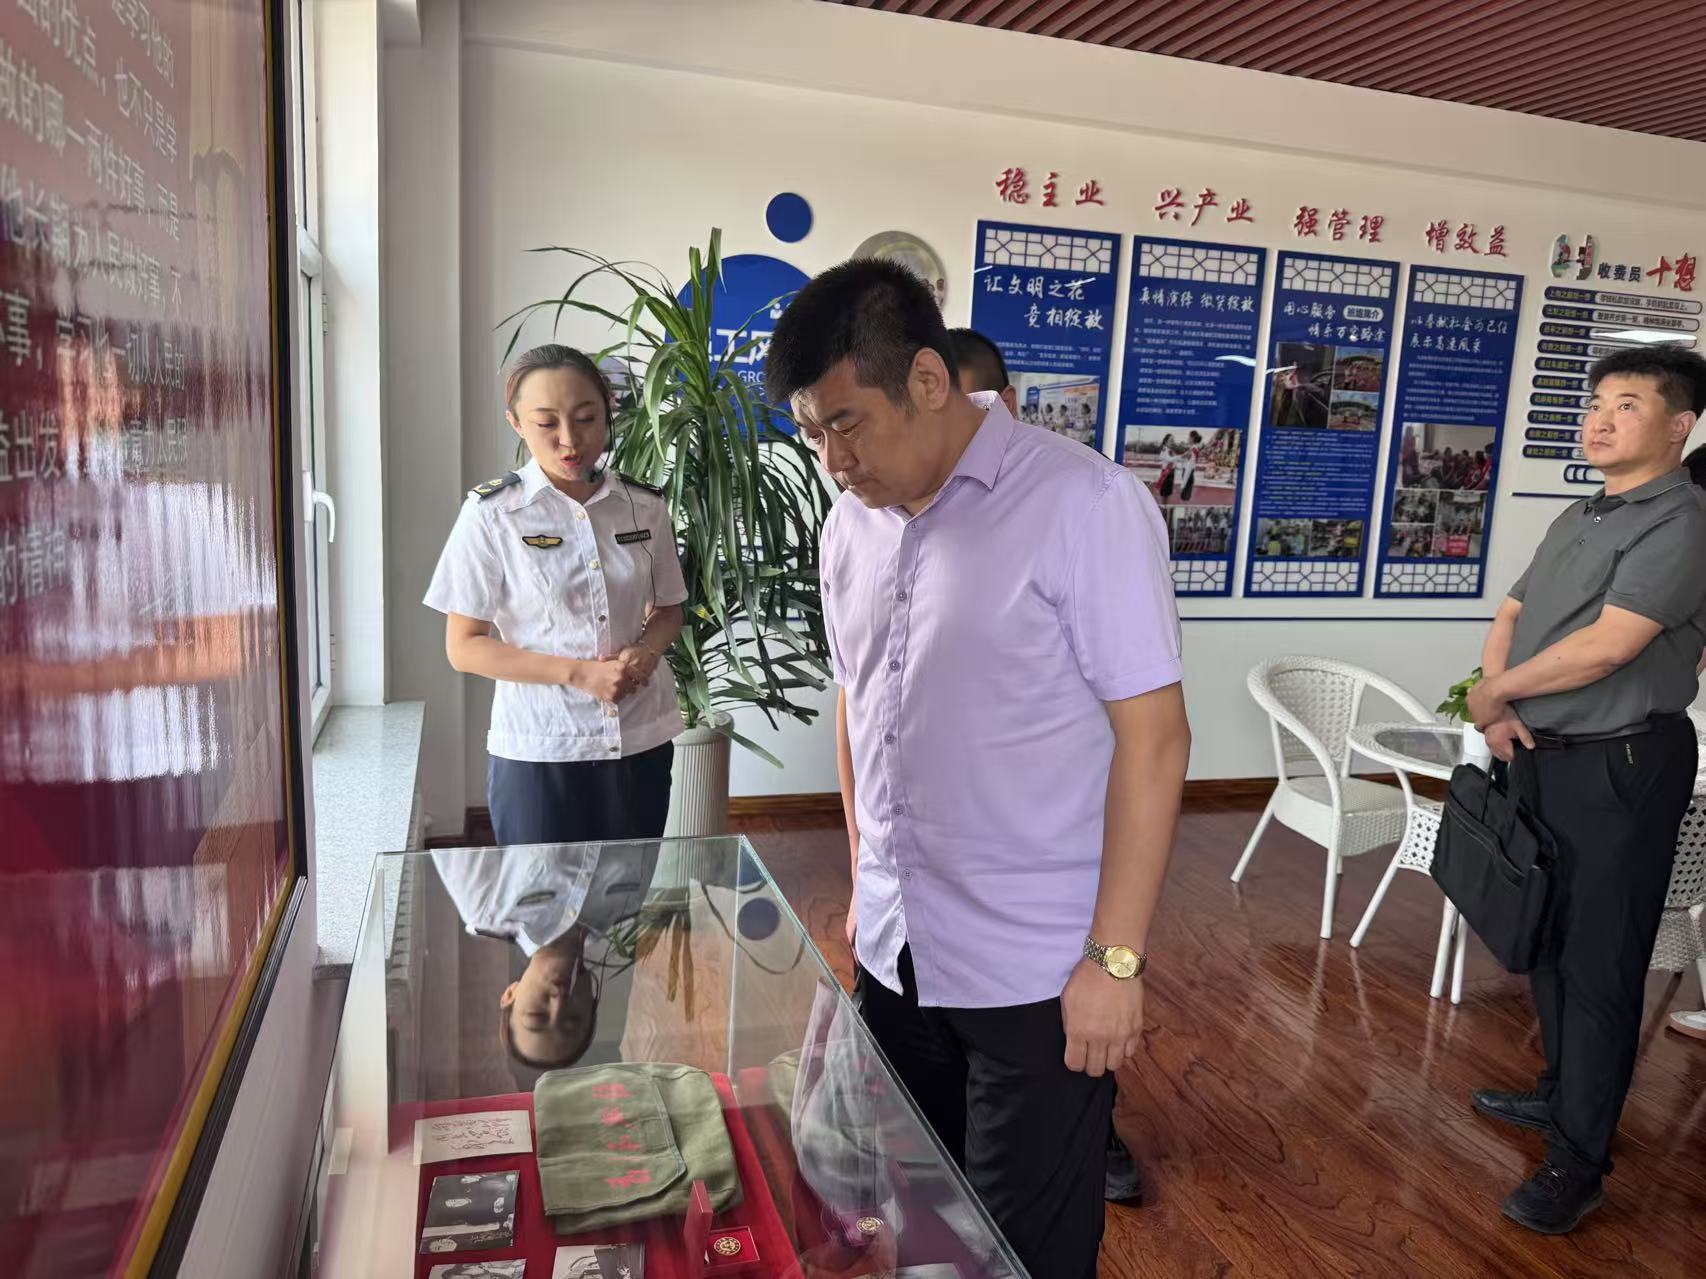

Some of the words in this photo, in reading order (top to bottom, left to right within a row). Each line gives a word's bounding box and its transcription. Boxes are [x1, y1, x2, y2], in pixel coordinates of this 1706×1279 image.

[995, 167, 1105, 208] 稳主业
[1153, 187, 1255, 227] 兴产业
[1293, 206, 1386, 244] 强管理
[1425, 219, 1508, 258] 增效益
[1597, 262, 1642, 283] 收费员
[1646, 252, 1698, 292] 十想
[984, 274, 1085, 301] 让文明之花
[1139, 286, 1194, 309] 真情演绎
[1200, 292, 1255, 313] 微笑绽放
[1024, 303, 1105, 331] 竞相绽放
[1283, 300, 1337, 320] 用心服务
[1410, 312, 1507, 334] 以奉献社会为己任
[1409, 332, 1481, 353] 展示高速风采
